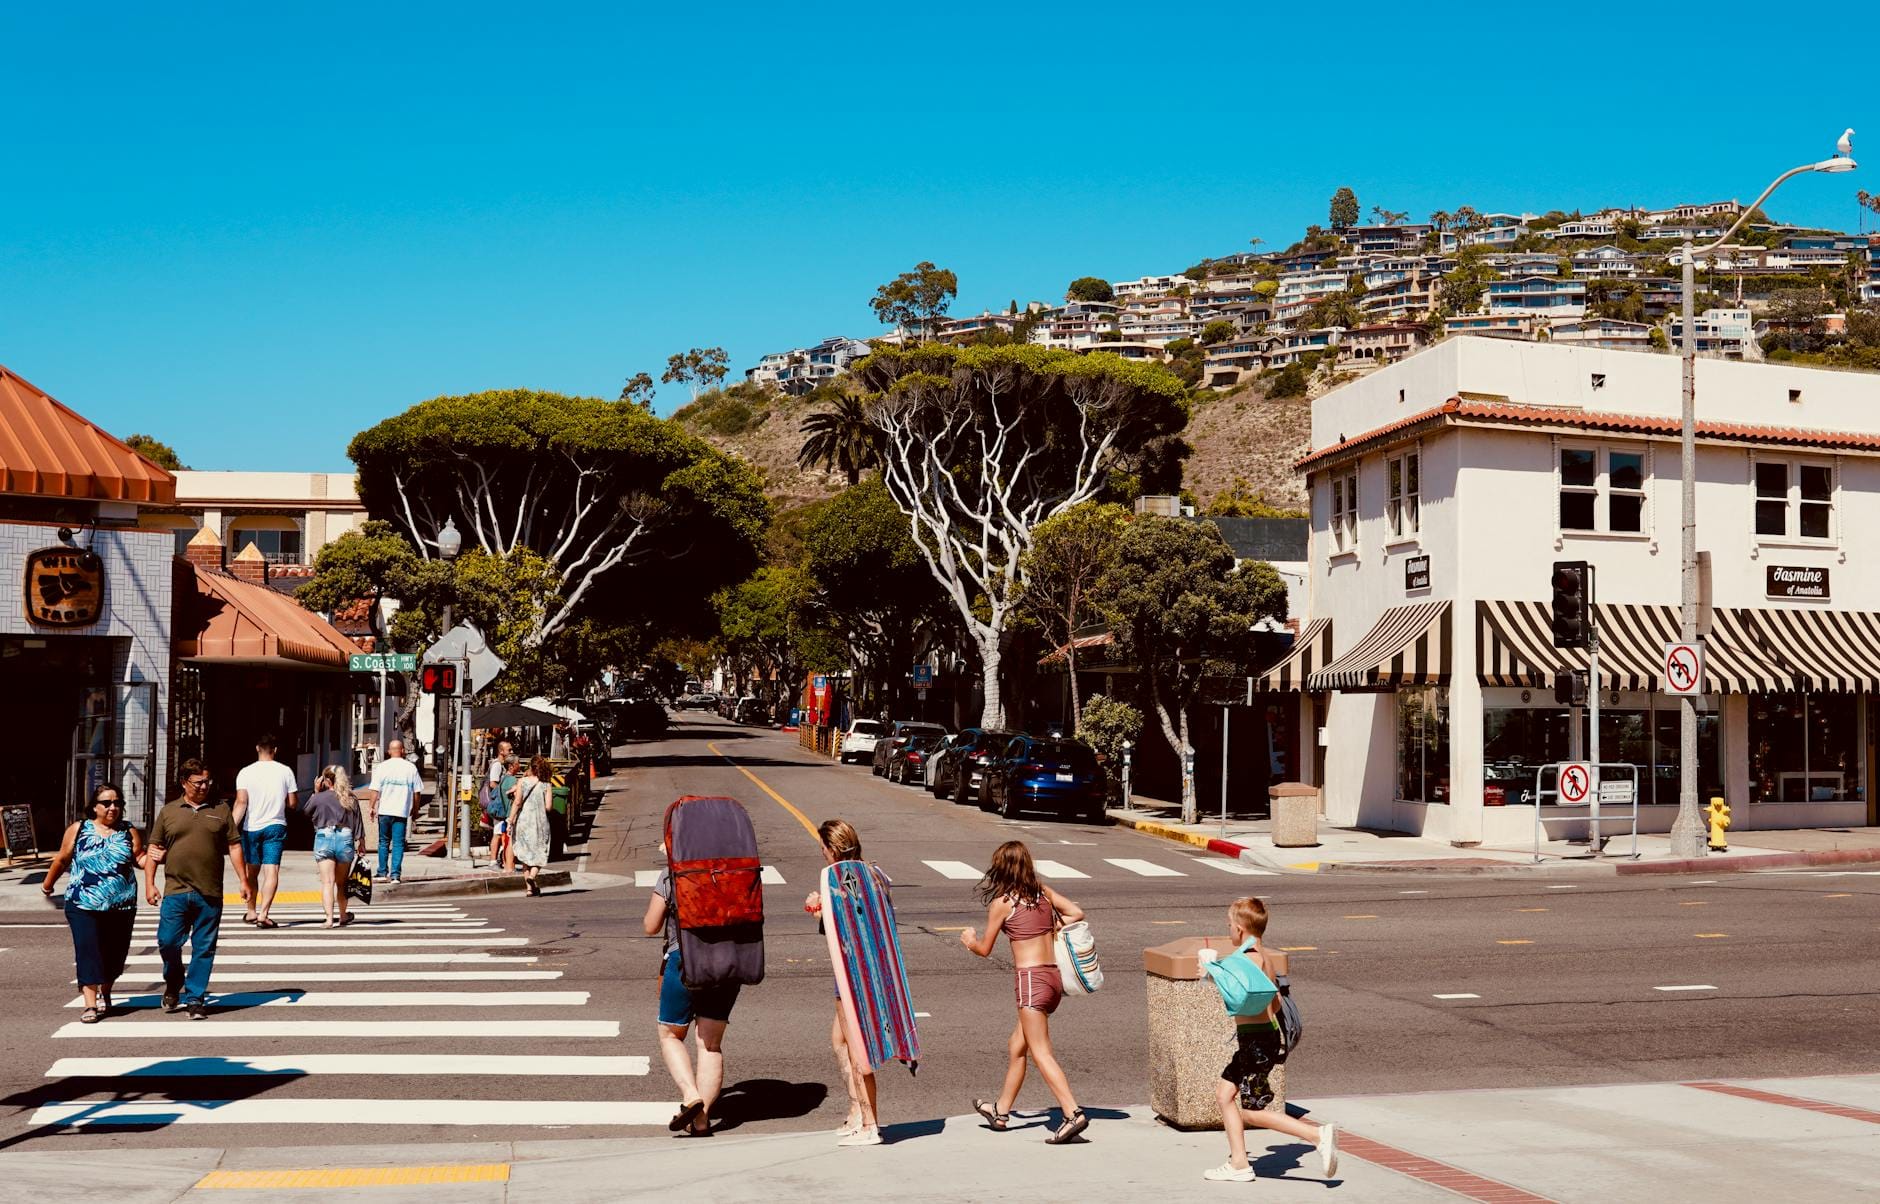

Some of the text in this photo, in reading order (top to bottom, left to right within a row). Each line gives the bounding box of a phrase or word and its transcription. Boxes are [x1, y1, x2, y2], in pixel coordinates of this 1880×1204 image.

[1773, 567, 1823, 583] Jasmine
[1786, 584, 1823, 596] of Anatolia
[352, 656, 396, 669] S. Coast
